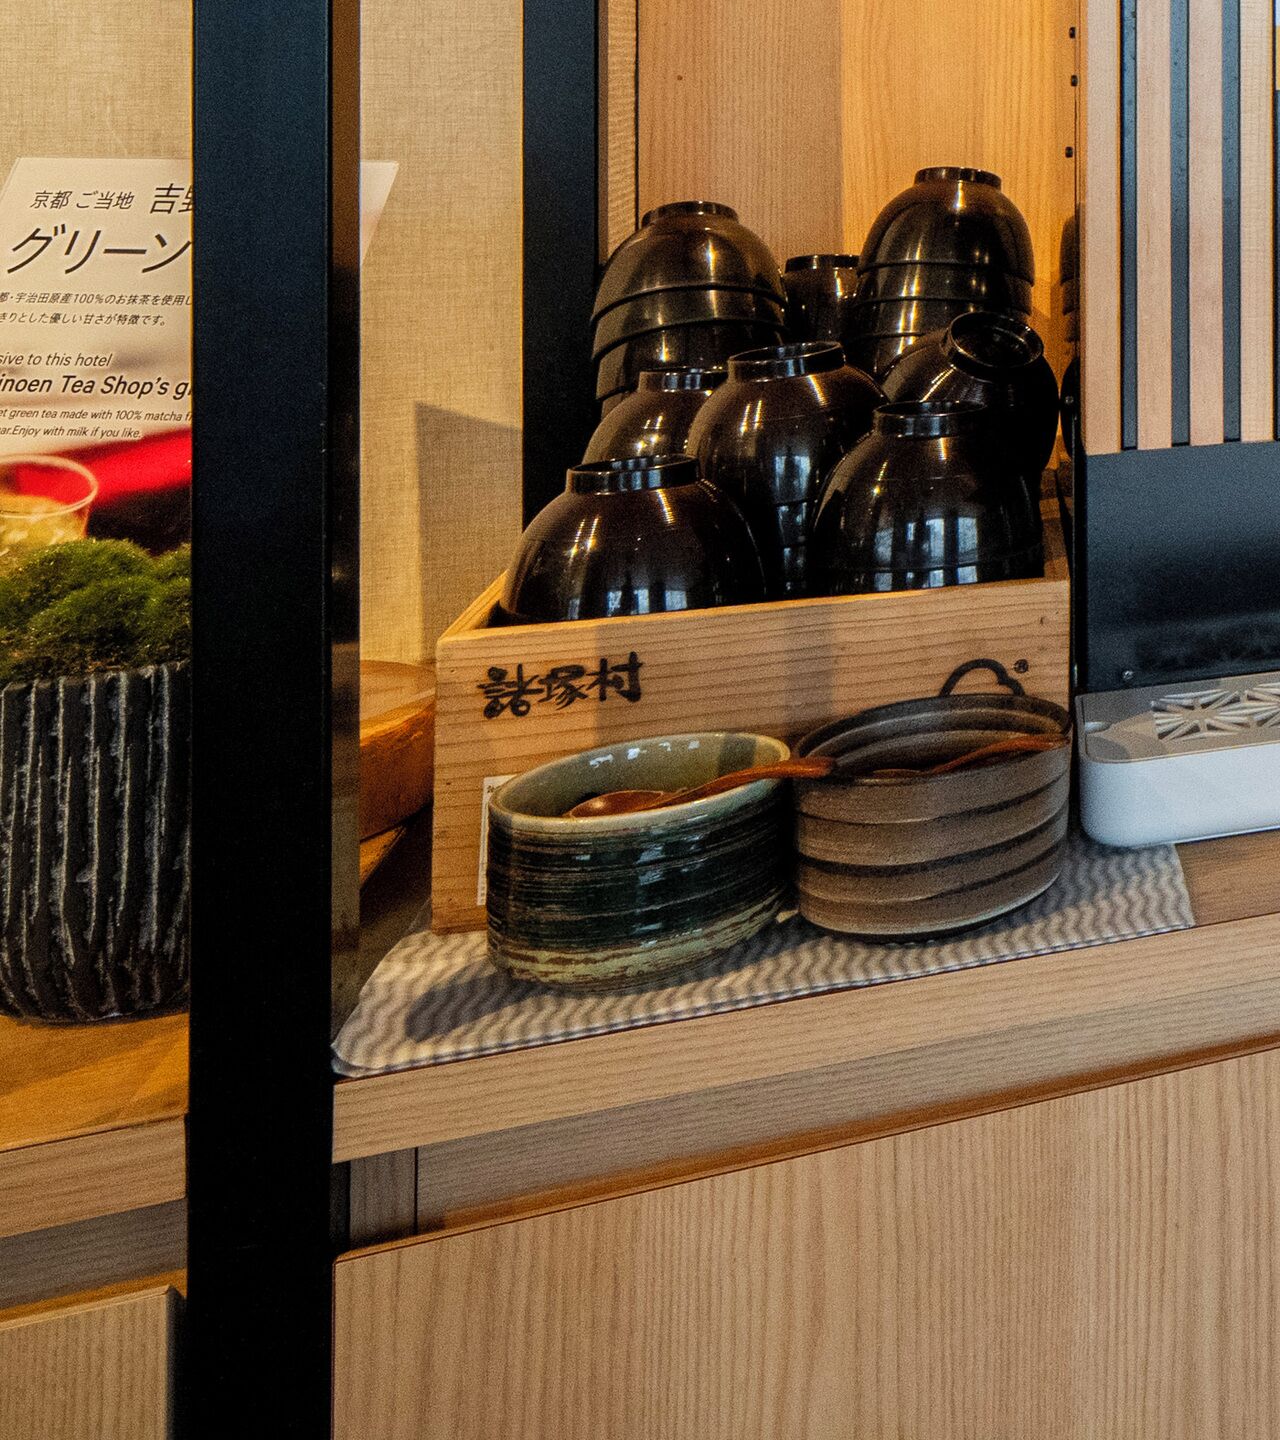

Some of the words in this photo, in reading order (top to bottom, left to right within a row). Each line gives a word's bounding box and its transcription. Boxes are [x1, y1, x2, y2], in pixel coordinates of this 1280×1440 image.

[30, 191, 73, 210] 京都
[76, 190, 135, 210] ご当地
[7, 223, 192, 274] グリーン
[27, 354, 42, 366] to
[45, 353, 71, 367] this
[74, 353, 113, 367] hotel
[0, 374, 52, 393] inoen
[61, 374, 96, 394] Tea
[100, 375, 170, 400] Shop's
[8, 410, 39, 420] green
[41, 409, 57, 419] tea
[59, 409, 88, 420] made
[90, 409, 113, 421] with
[115, 410, 142, 421] 100%
[144, 412, 182, 422] matcha
[43, 426, 65, 437] with
[66, 426, 89, 438] milk
[90, 427, 99, 438] if
[100, 429, 119, 440] you
[121, 427, 142, 439] like.
[477, 651, 644, 719] 諸塚村
